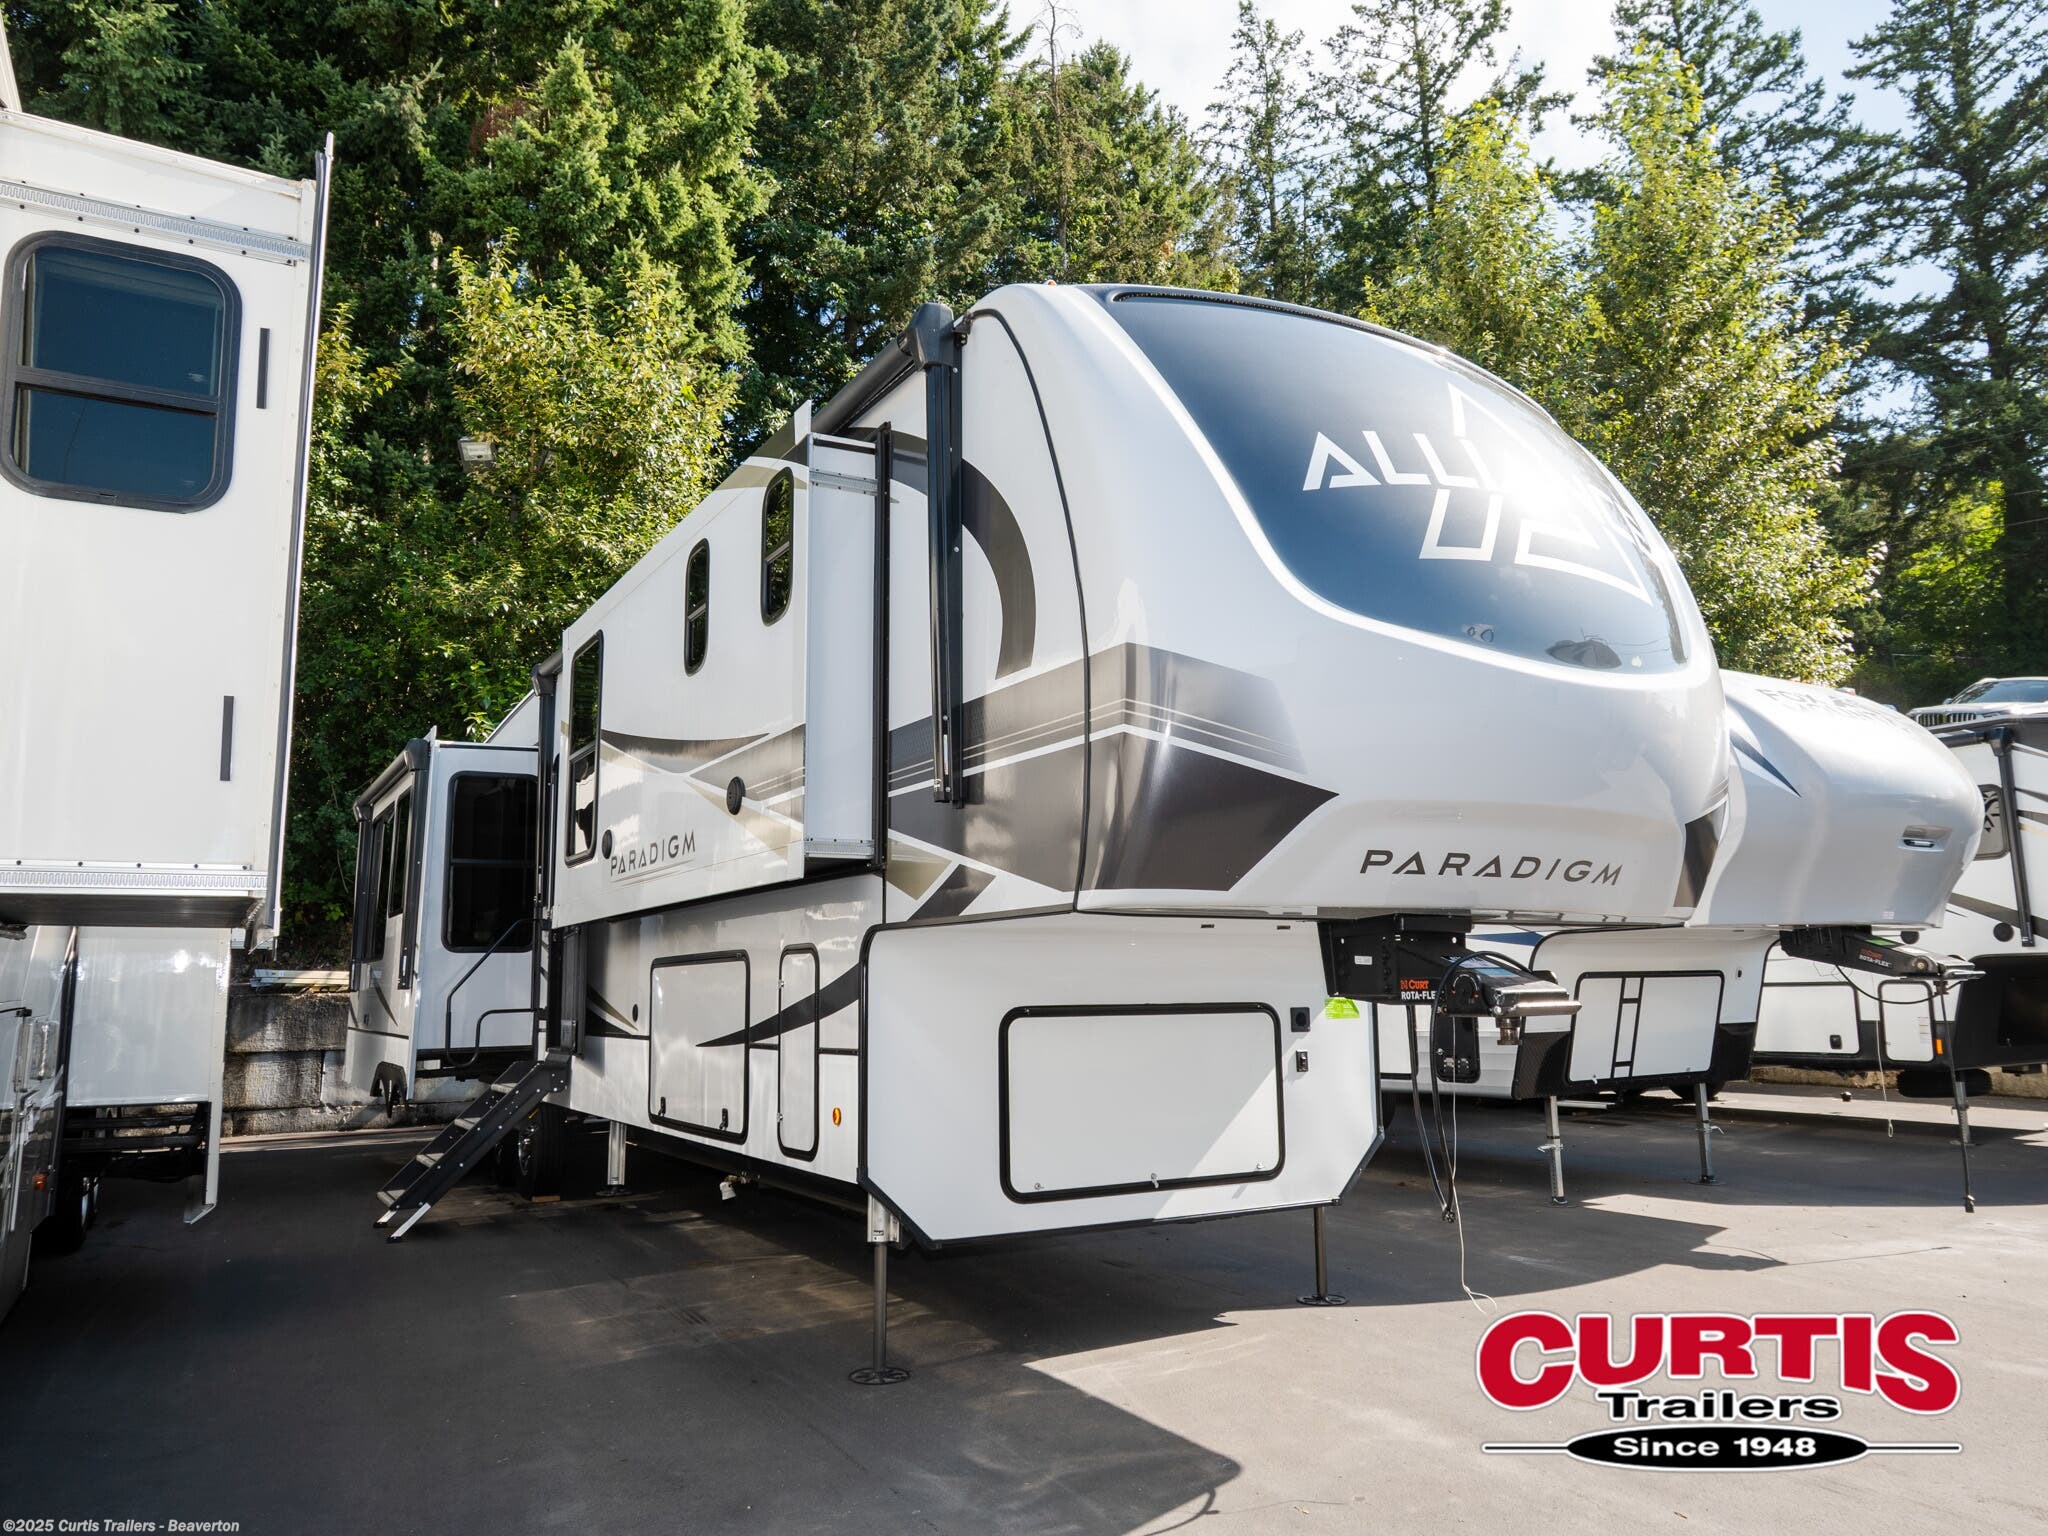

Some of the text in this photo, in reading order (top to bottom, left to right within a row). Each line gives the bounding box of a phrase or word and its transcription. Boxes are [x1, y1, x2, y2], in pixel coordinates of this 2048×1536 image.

[610, 829, 695, 877] PARADIGM
[1360, 849, 1623, 885] PARADIGM
[1401, 990, 1436, 1000] ROTA-FLE
[1409, 979, 1429, 990] CURT
